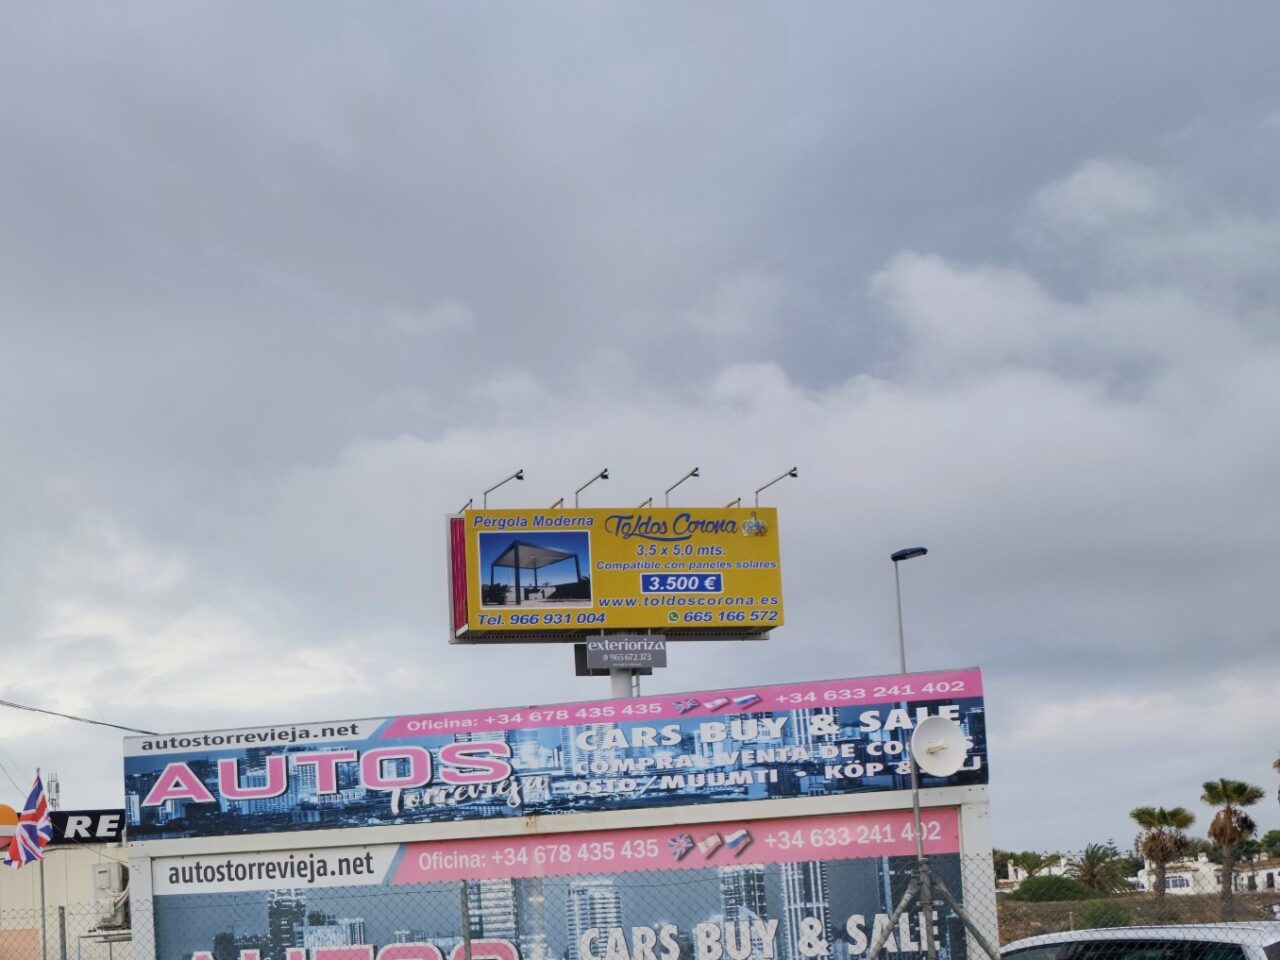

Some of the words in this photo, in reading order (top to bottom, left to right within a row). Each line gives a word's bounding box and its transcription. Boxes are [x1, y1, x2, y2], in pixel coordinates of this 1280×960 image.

[473, 515, 528, 530] Pérgola
[532, 515, 594, 527] Moderna
[604, 514, 668, 541] Toldos
[672, 513, 737, 537] Corona
[636, 544, 657, 557] 3,5
[660, 546, 668, 555] x
[673, 544, 693, 557] 5,0
[696, 544, 726, 556] mts.
[596, 561, 661, 571] Compatible
[664, 561, 685, 569] con
[688, 561, 732, 571] paneles
[735, 560, 777, 569] solares
[648, 576, 699, 590] 3.500
[703, 576, 717, 590] €
[599, 596, 778, 607] www.toldoscorona.es
[478, 614, 505, 625] Tel.
[510, 614, 539, 625] 966
[543, 613, 571, 624] 931
[577, 613, 605, 624] 004
[683, 612, 713, 622] 665
[718, 612, 745, 622] 166
[749, 611, 778, 621] 572
[588, 638, 665, 651] exterioriza
[141, 723, 359, 751] autostorrevieja.net
[407, 718, 478, 732] Oficina:
[484, 713, 523, 725] +34
[529, 710, 569, 722] 678
[575, 706, 615, 719] 435
[622, 703, 662, 716] 435
[775, 692, 817, 704] +34
[823, 688, 867, 700] 633
[872, 685, 916, 697] 241
[921, 681, 965, 693] 402
[575, 724, 683, 750] CARS
[700, 716, 788, 743] BUY
[809, 714, 841, 736] &
[575, 755, 694, 775] COMPRA
[720, 747, 810, 766] VENTA
[820, 743, 855, 759] DE
[141, 740, 516, 807] AUTOS
[570, 768, 779, 795] OSTO/MUUMTI
[824, 760, 884, 780] KÖP
[384, 775, 552, 816] Torrevieja
[168, 851, 375, 884] autostorrevieja.net
[419, 850, 486, 871] Oficina:
[491, 847, 528, 867] +34
[534, 844, 571, 864] 678
[577, 842, 615, 861] 435
[620, 839, 659, 859] 435
[765, 830, 804, 849] +34
[810, 828, 851, 847] 633
[857, 824, 896, 843] 241
[798, 916, 831, 957] &
